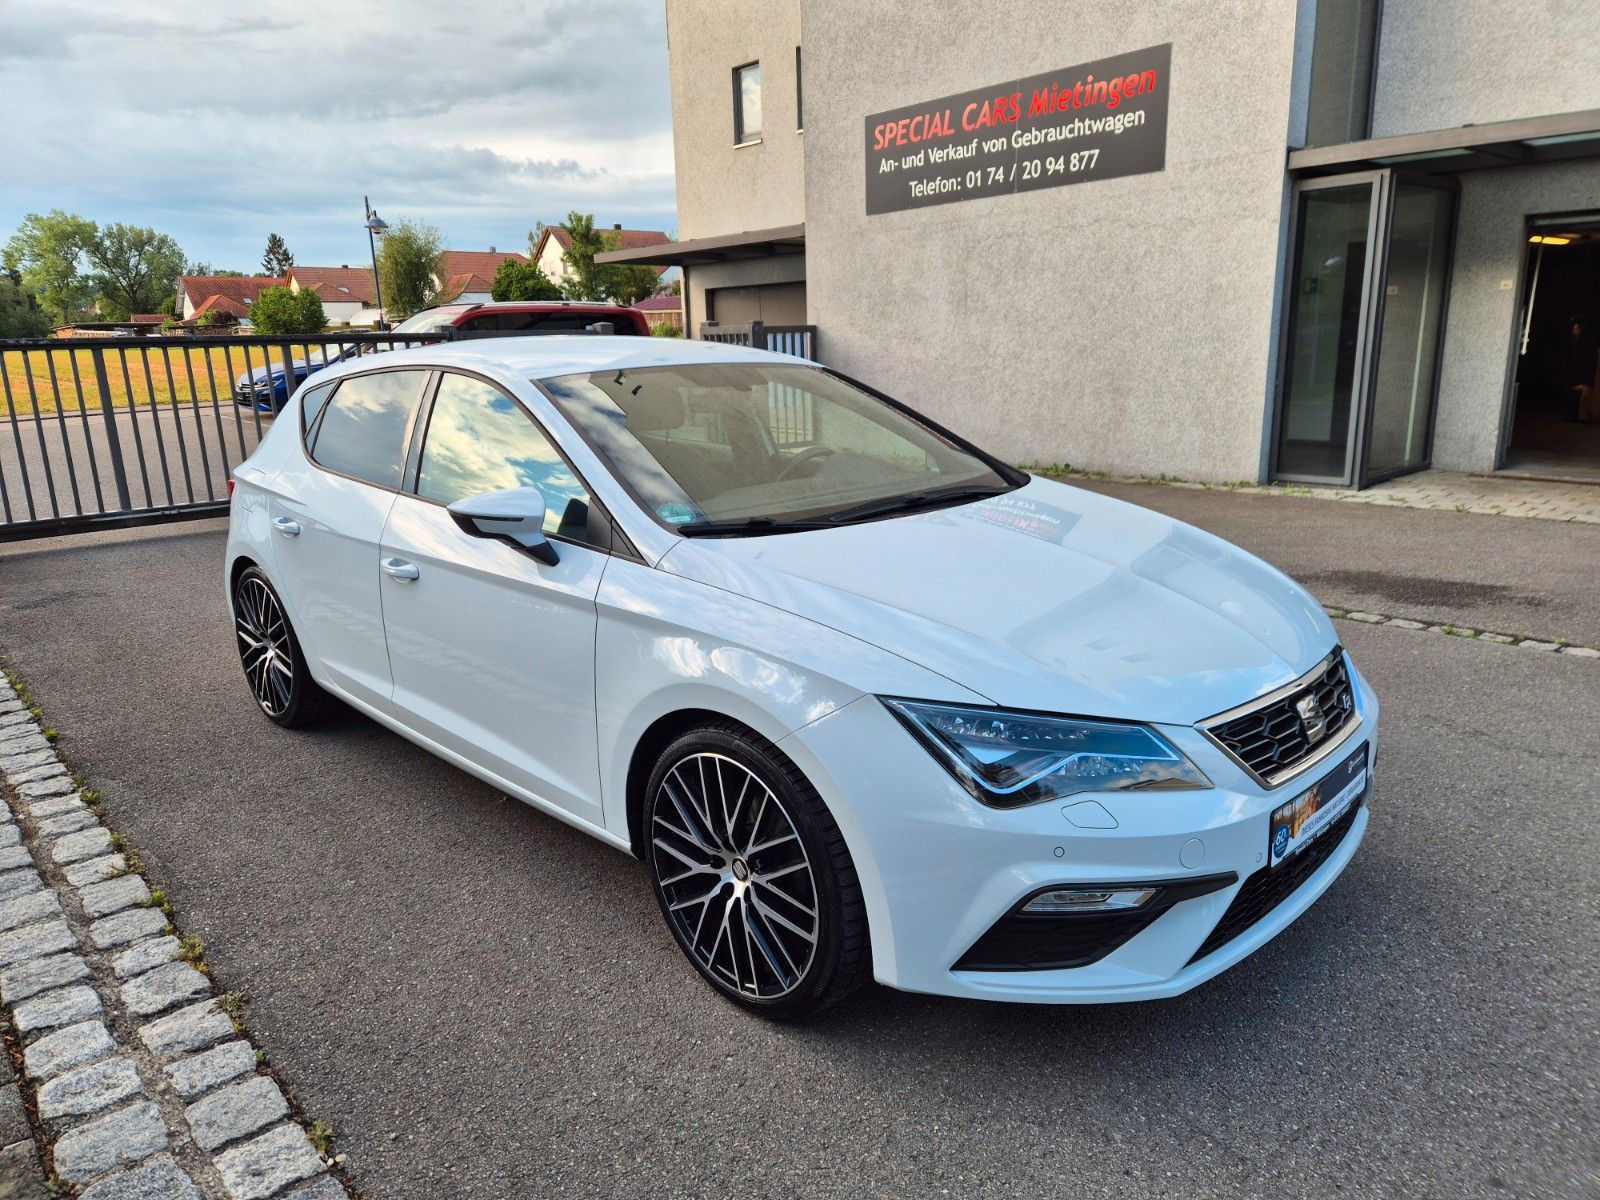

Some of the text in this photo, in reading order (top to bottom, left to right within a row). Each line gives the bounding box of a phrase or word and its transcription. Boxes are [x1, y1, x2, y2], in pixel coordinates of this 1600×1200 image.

[873, 69, 1157, 150] SPECIAL CARS Mietingen
[879, 109, 1145, 174] An- und Verkauf von Gebrauchtwagen
[909, 149, 1100, 197] Telefon: 01 74 / 20 94 877
